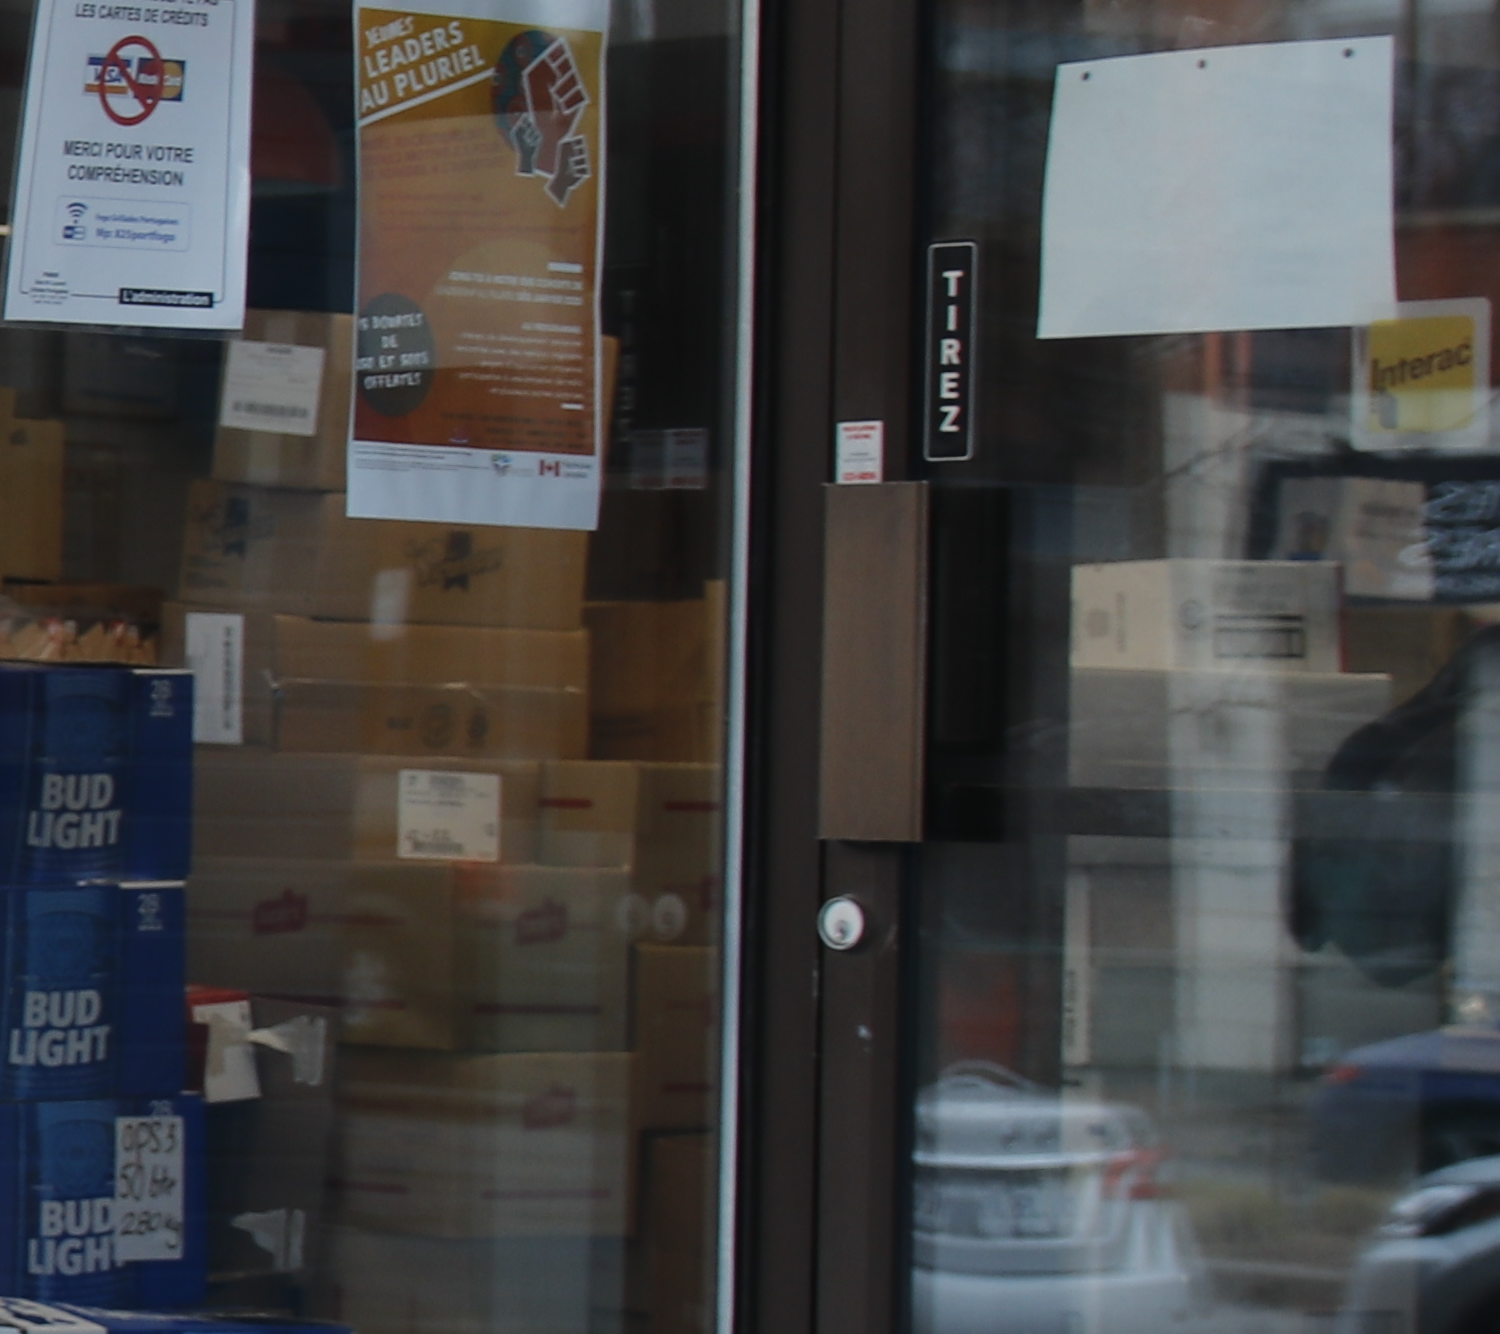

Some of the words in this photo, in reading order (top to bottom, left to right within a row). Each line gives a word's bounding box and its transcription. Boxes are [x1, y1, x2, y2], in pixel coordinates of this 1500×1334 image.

[75, 3, 96, 18] LES
[99, 5, 140, 21] CARTES
[145, 9, 158, 22] DE
[161, 8, 208, 26] CRÉDITS
[364, 21, 465, 78] LEADERS
[360, 81, 389, 112] AU
[393, 44, 486, 97] PLURIEL
[63, 140, 103, 158] MERCI
[105, 144, 142, 160] POUR
[146, 146, 194, 163] VOTRE
[67, 164, 185, 186] COMPRÉHENSION
[122, 288, 211, 306] L'administration
[939, 270, 964, 432] TIREZ
[1371, 341, 1472, 391] Interac
[40, 773, 114, 810] BUD
[27, 809, 122, 849] LIGHT
[23, 989, 102, 1028] BUD
[8, 1025, 111, 1067] LIGHT
[40, 1197, 116, 1237] BUD
[27, 1235, 120, 1276] LIGH
